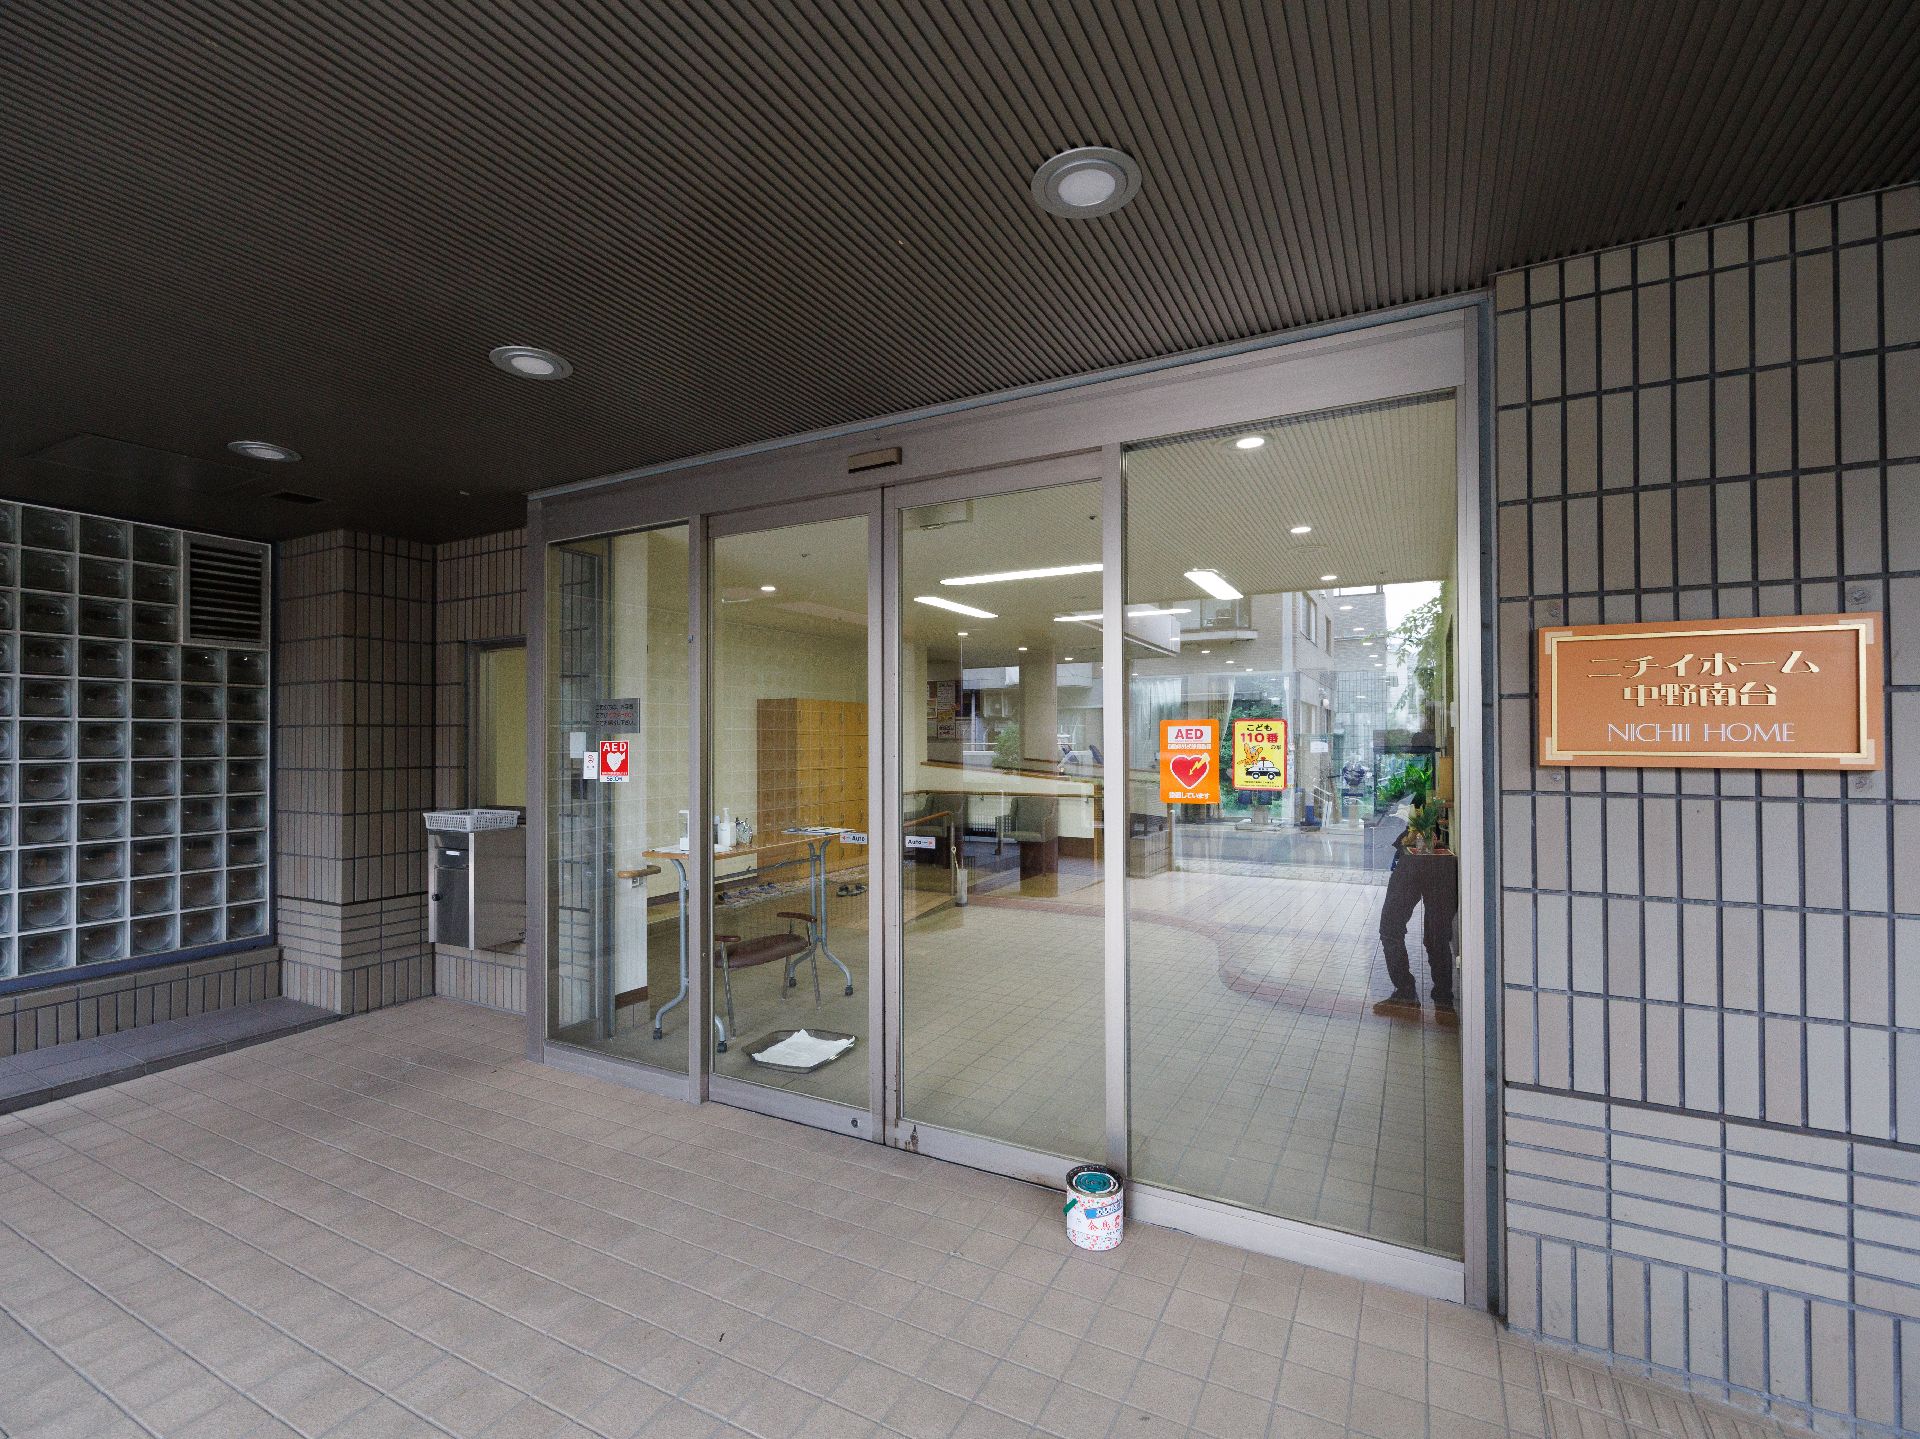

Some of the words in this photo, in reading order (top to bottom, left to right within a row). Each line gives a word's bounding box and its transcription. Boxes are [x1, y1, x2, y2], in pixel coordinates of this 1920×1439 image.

[1586, 651, 1820, 679] ニチイホーム
[1623, 681, 1778, 707] 中野南台
[1175, 729, 1204, 739] AED
[1240, 732, 1278, 743] 110番
[1607, 723, 1691, 742] NICHII
[1703, 723, 1796, 742] HOME
[603, 743, 626, 751] AED
